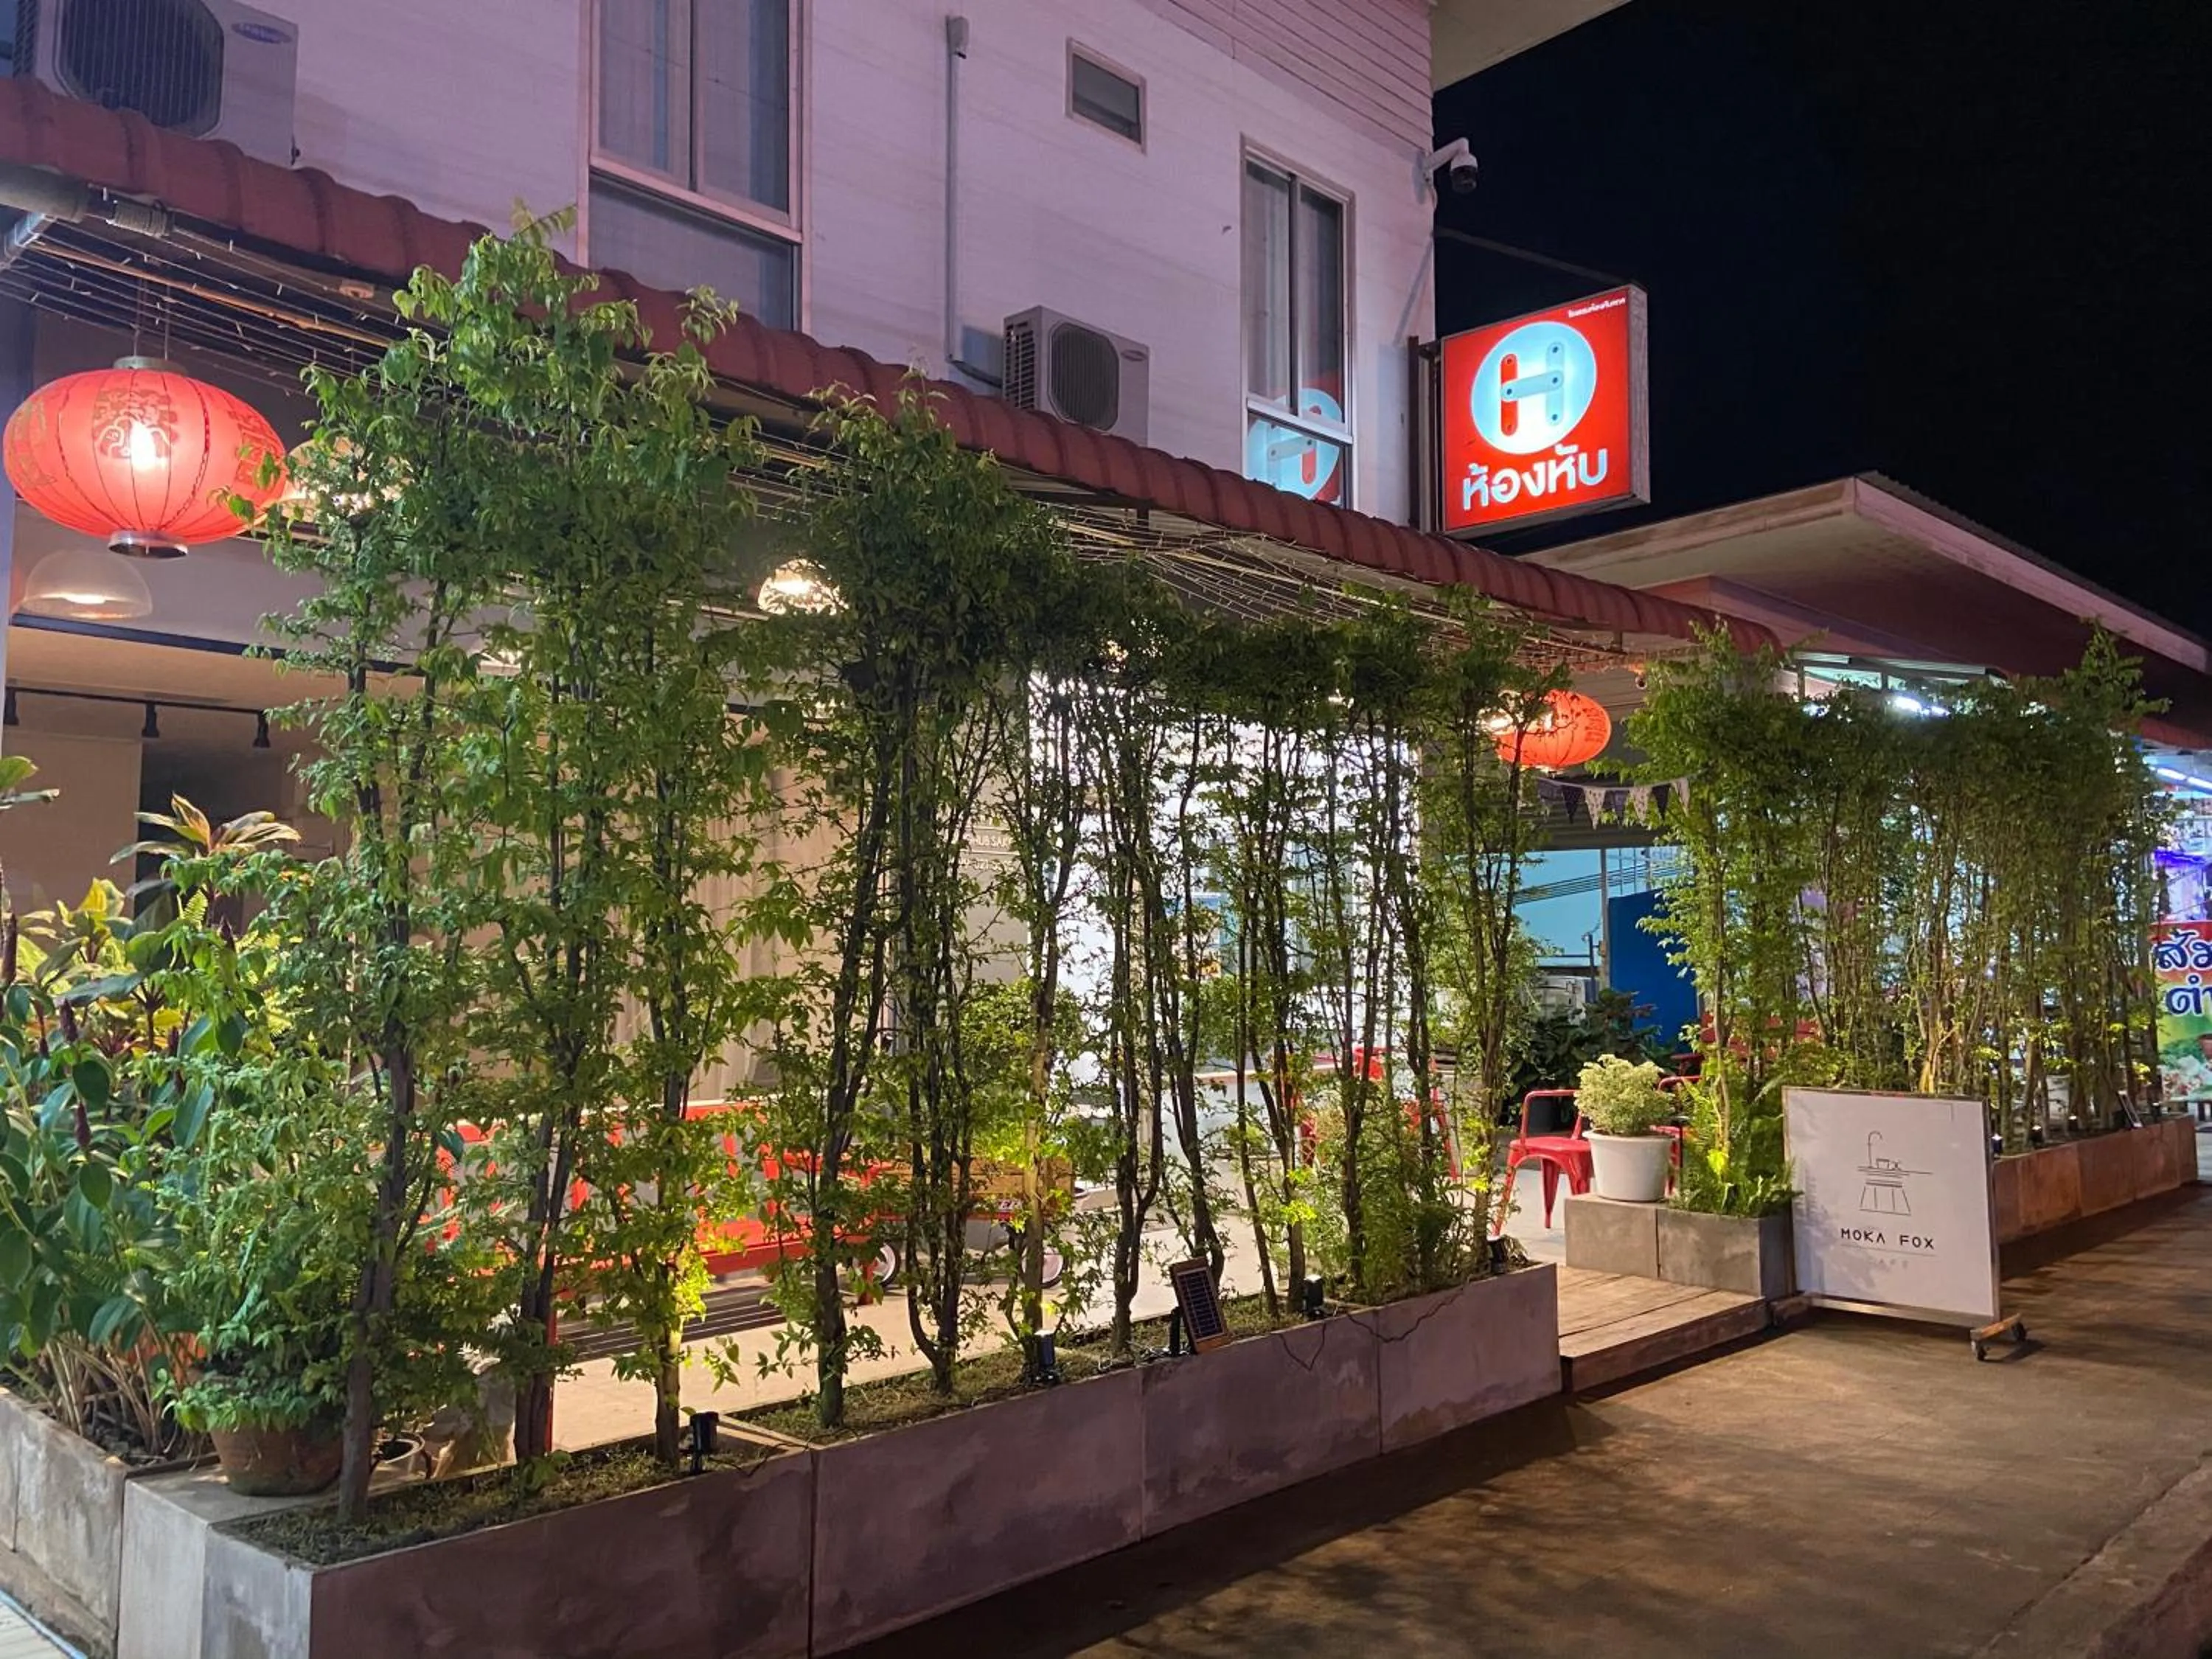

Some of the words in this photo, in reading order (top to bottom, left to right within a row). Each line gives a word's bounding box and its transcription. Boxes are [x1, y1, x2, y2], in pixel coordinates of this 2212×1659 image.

[1462, 443, 1608, 510] ห้องหับ
[1840, 1228, 1885, 1245] MOKA
[1899, 1234, 1934, 1250] FOX
